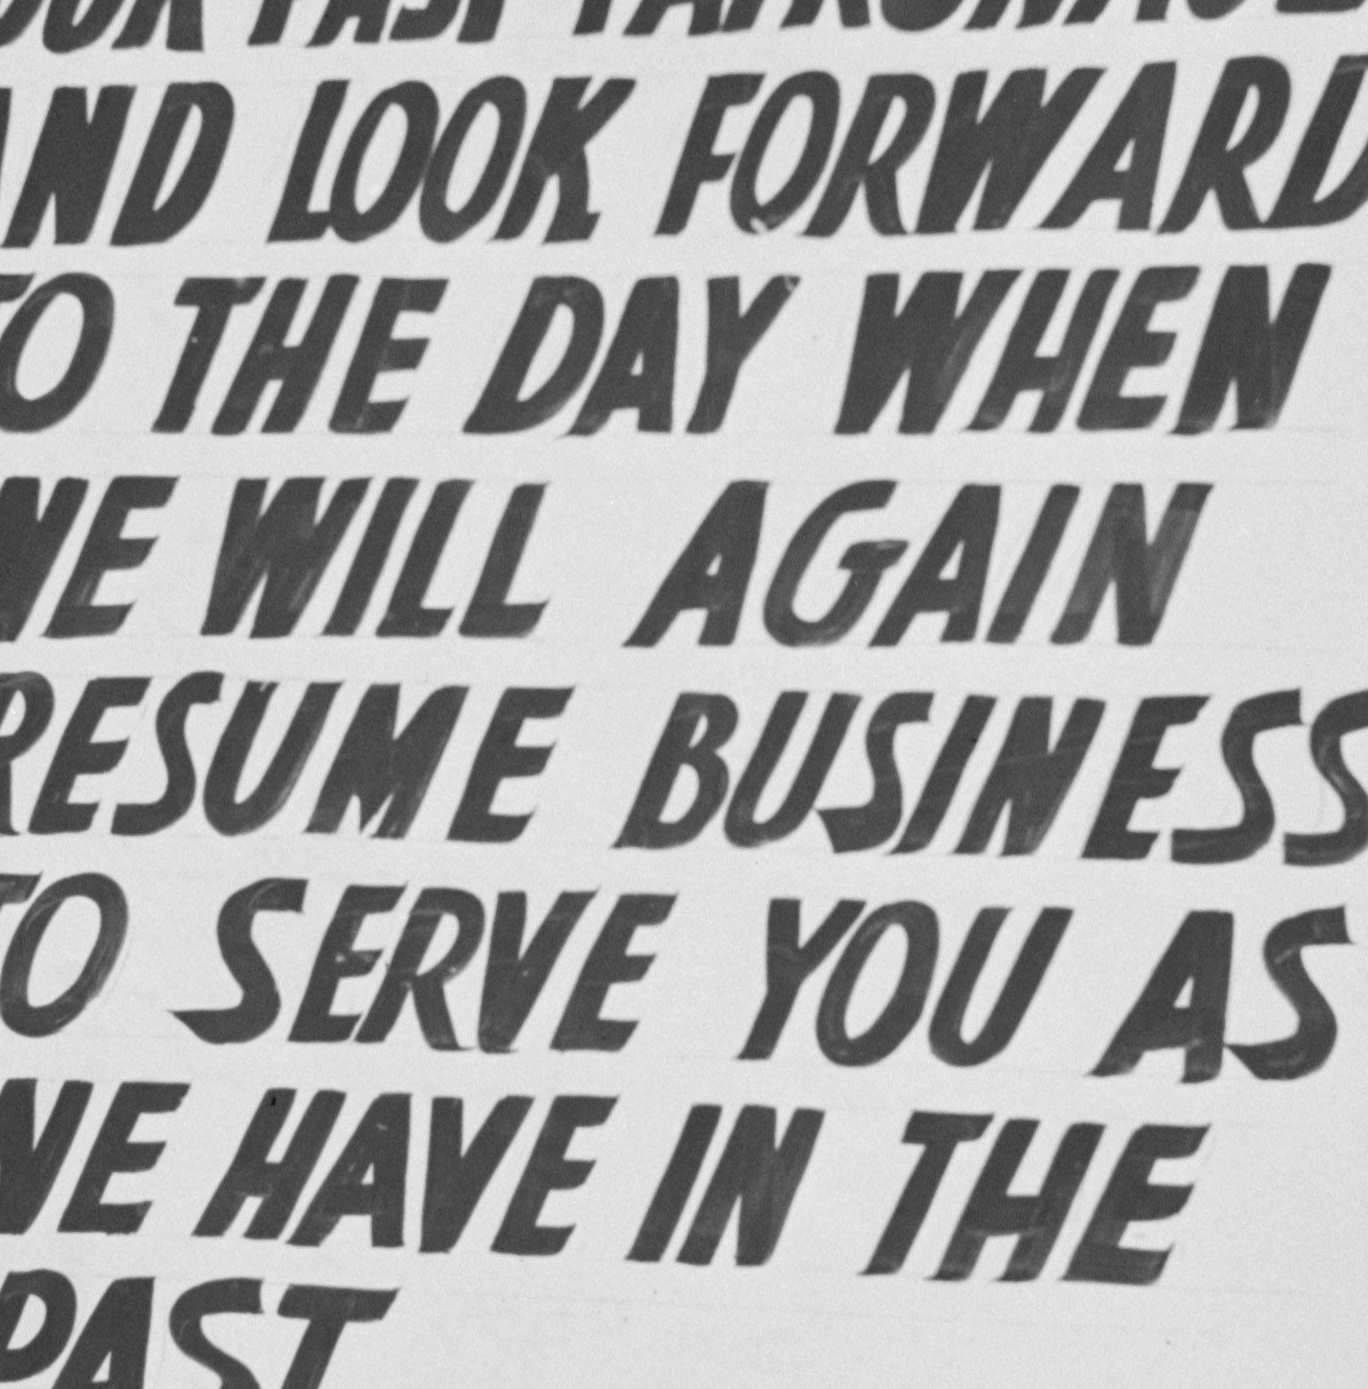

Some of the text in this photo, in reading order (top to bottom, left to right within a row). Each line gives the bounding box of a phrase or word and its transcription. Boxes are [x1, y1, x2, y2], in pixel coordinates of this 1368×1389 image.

[266, 74, 637, 244] LOOK
[151, 273, 449, 437] THE
[461, 274, 801, 437] DAY
[833, 262, 1333, 437] WHEN
[199, 476, 547, 640] WILL
[622, 479, 1214, 649] AGAIN
[172, 876, 678, 1055] SERVE
[736, 897, 1074, 1068] YOU
[1090, 905, 1352, 1085] AS
[191, 1087, 619, 1257] HAVE
[625, 1103, 825, 1267] IN
[861, 1110, 1210, 1286] THE
